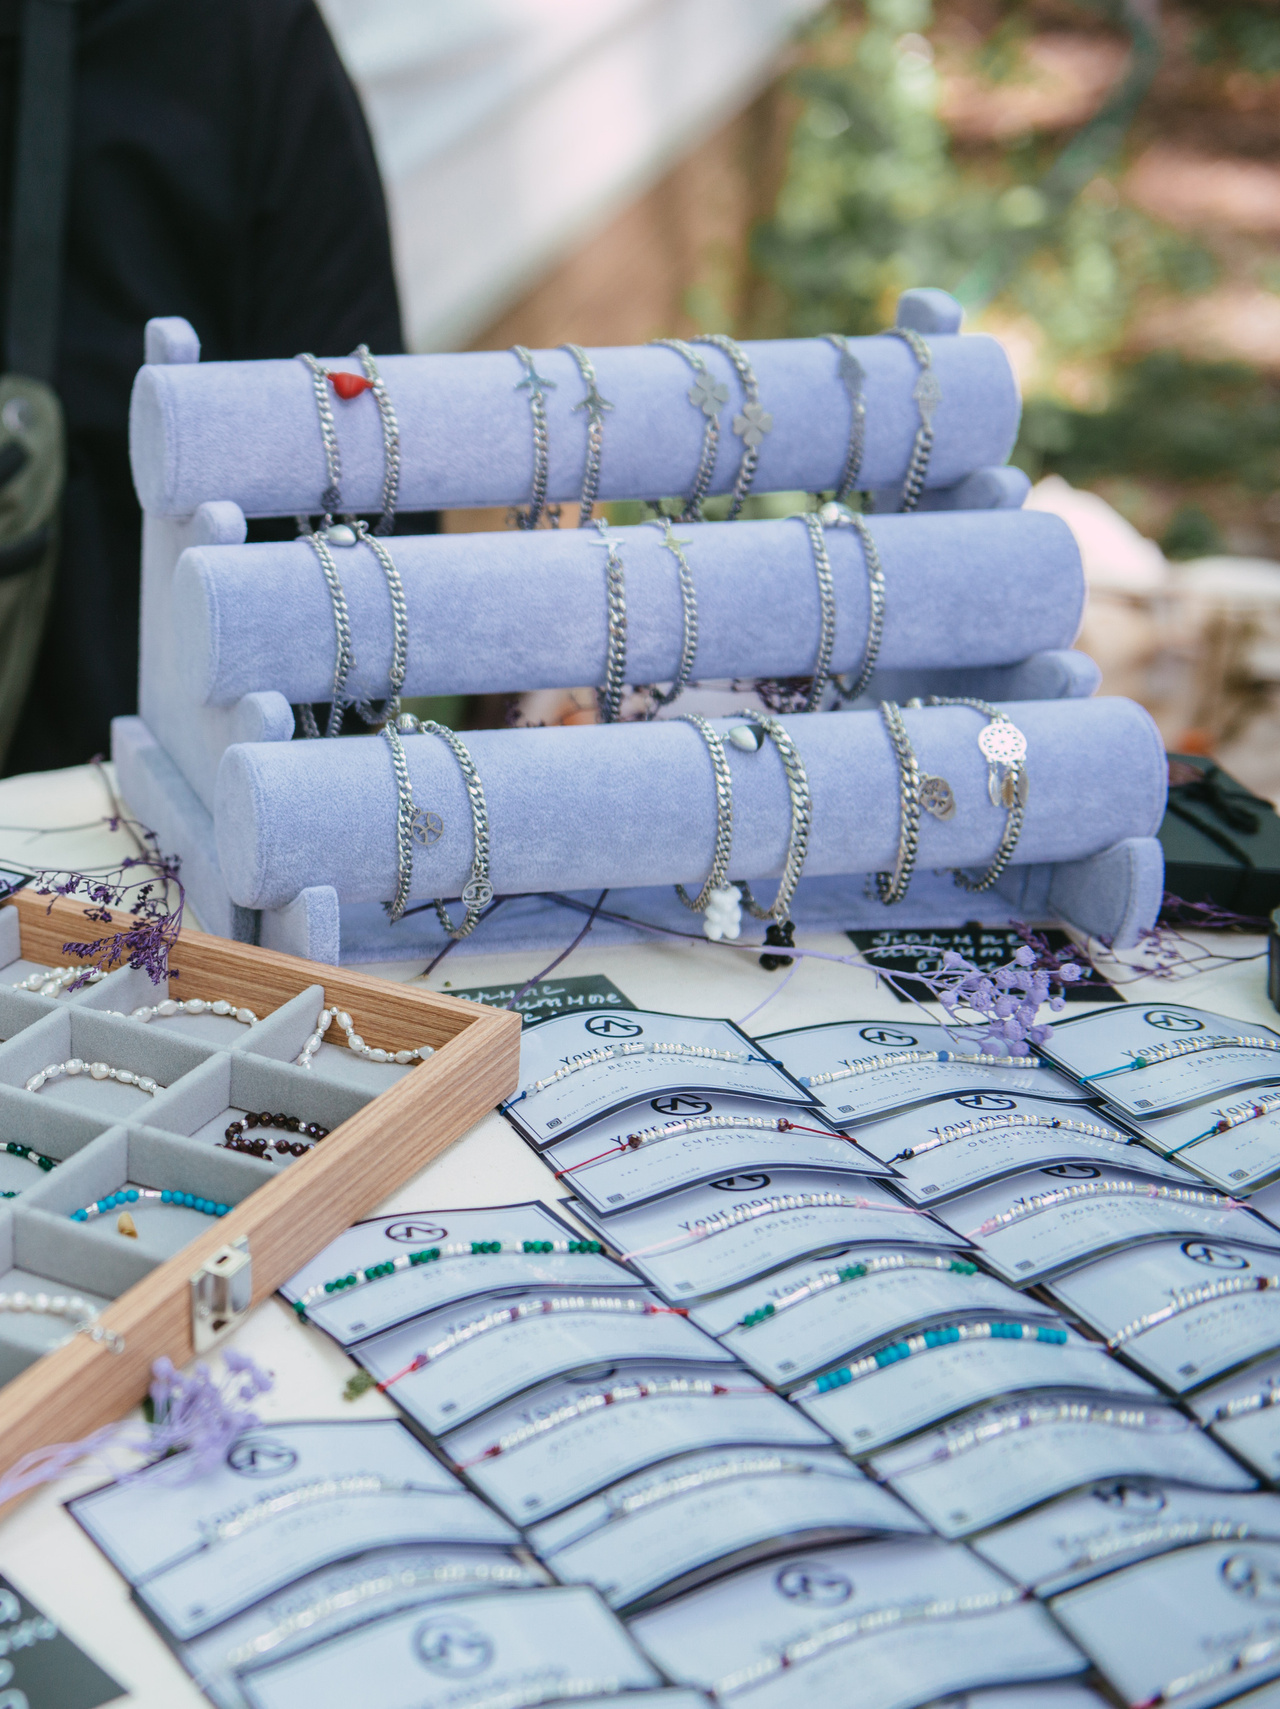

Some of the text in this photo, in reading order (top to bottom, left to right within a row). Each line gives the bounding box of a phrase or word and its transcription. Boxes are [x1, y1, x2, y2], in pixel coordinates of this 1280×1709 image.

[1120, 1043, 1169, 1059] Your
[871, 1064, 933, 1081] СЧАСТЬЕ
[1211, 1100, 1257, 1119] Your
[681, 1132, 756, 1148] СЧАСТЬЕ
[968, 1128, 1048, 1148] ОБНИМАЮ
[677, 1208, 730, 1232] Your
[753, 1213, 817, 1234] ЛЮБЛЮ
